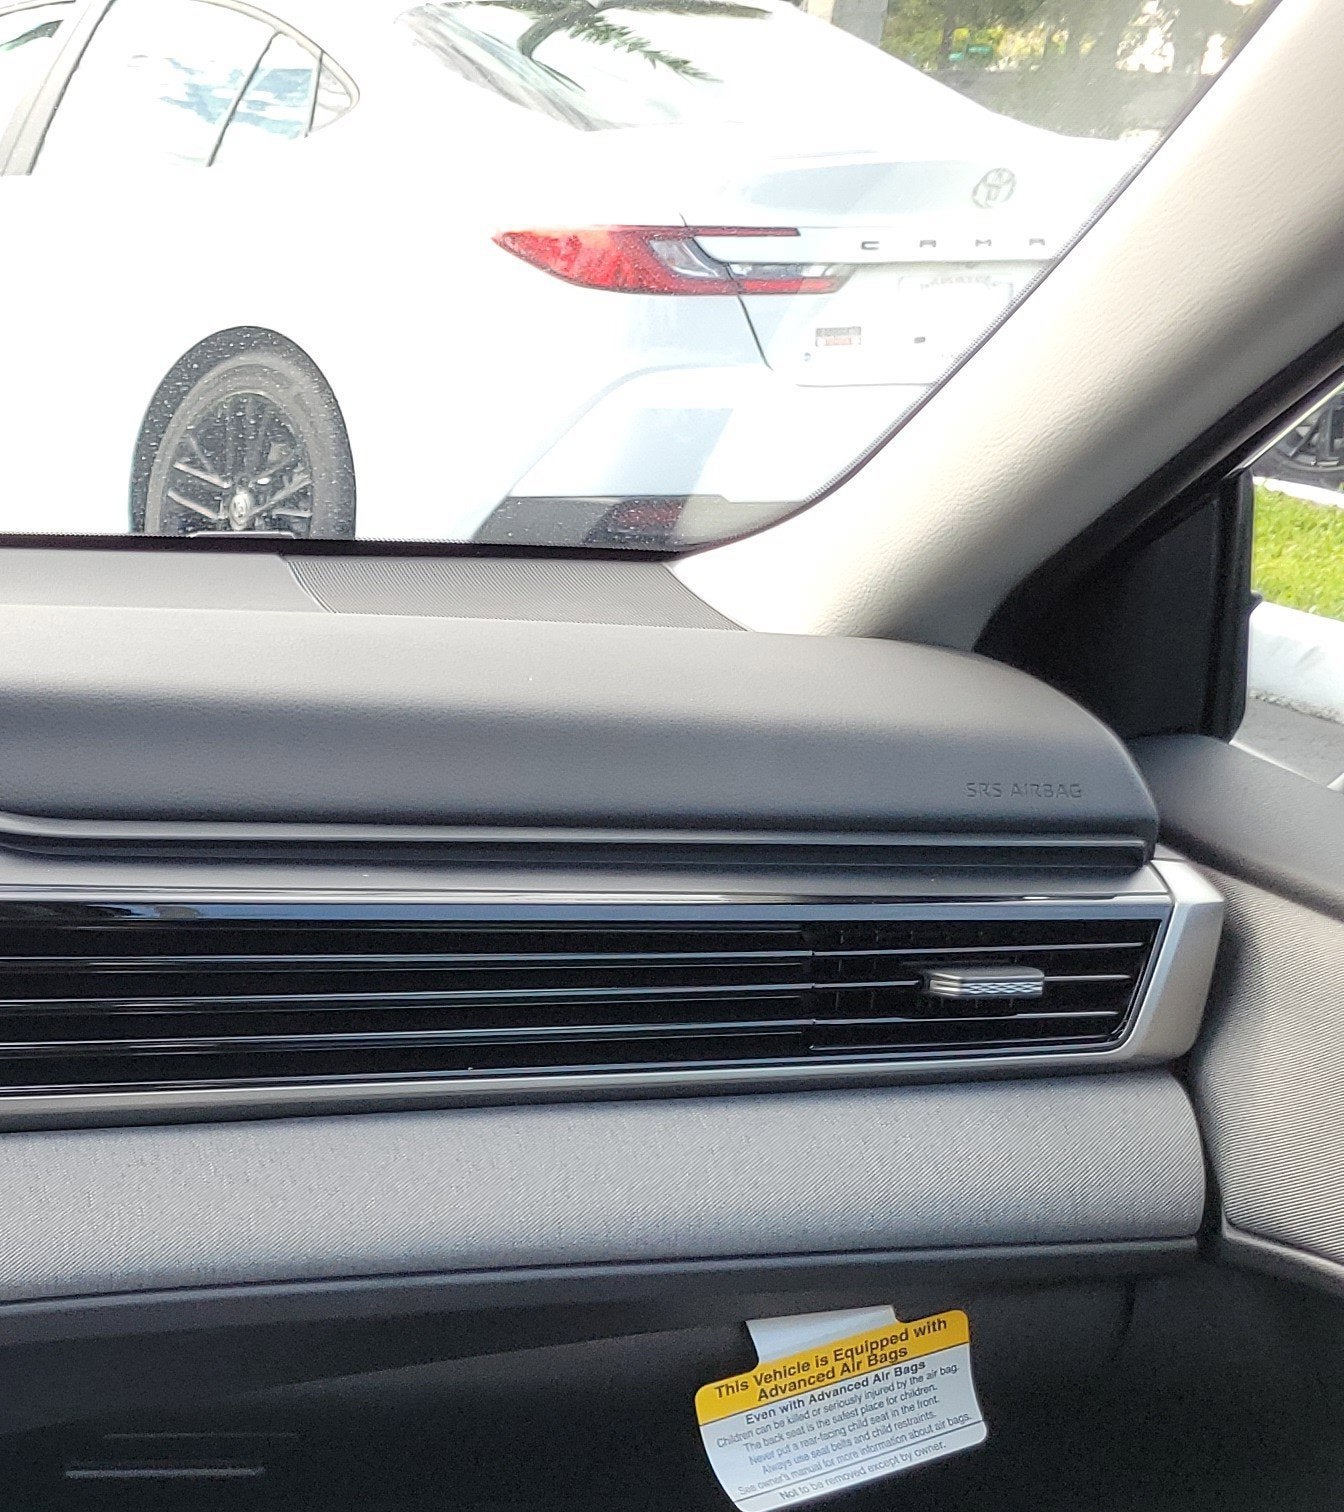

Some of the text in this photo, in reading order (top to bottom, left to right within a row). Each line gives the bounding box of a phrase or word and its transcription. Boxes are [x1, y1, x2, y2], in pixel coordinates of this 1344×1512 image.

[965, 782, 1082, 798] SRS AIRBAG
[714, 1318, 947, 1398] This Vehicle is Equipped with
[758, 1347, 907, 1401] Advanced Air Bags
[745, 1361, 925, 1424] Even with Advanced Air Bags
